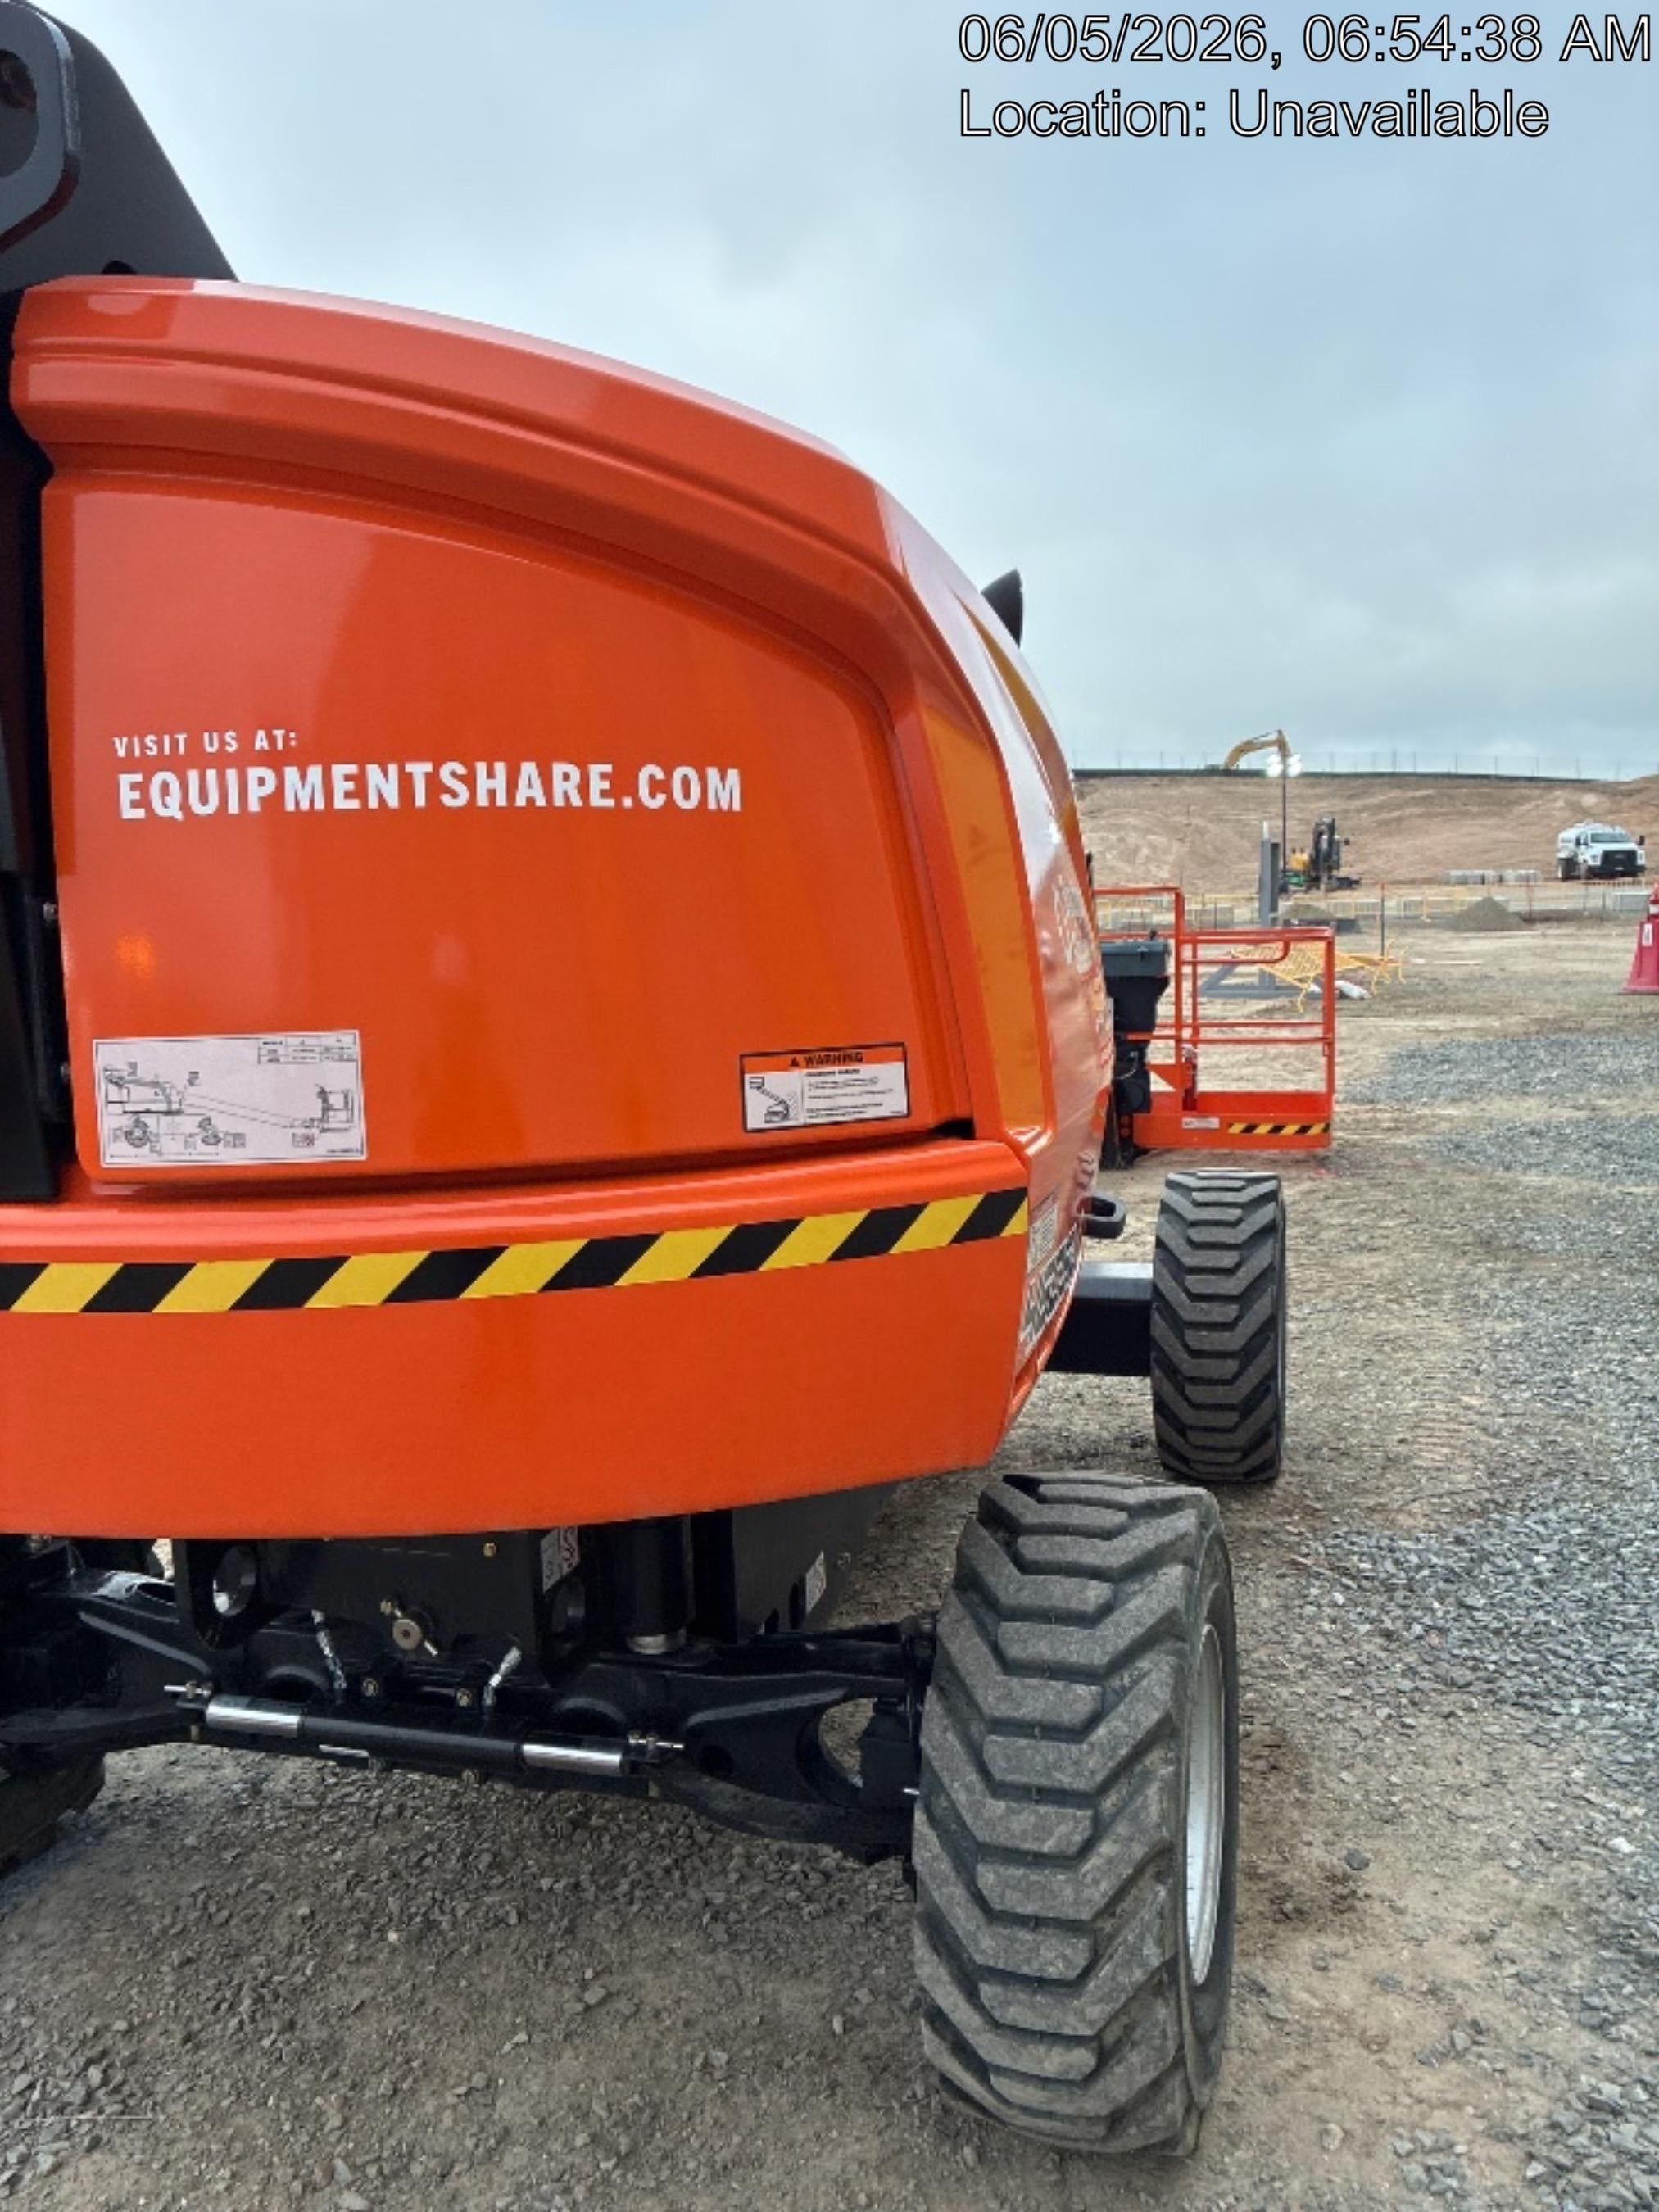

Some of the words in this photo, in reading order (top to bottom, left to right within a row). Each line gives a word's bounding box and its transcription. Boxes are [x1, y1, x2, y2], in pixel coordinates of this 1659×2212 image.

[112, 732, 188, 758] VISIT
[202, 729, 239, 754] US
[254, 728, 299, 751] AT:
[117, 759, 743, 822] EQUIPMENTSHARE.COM
